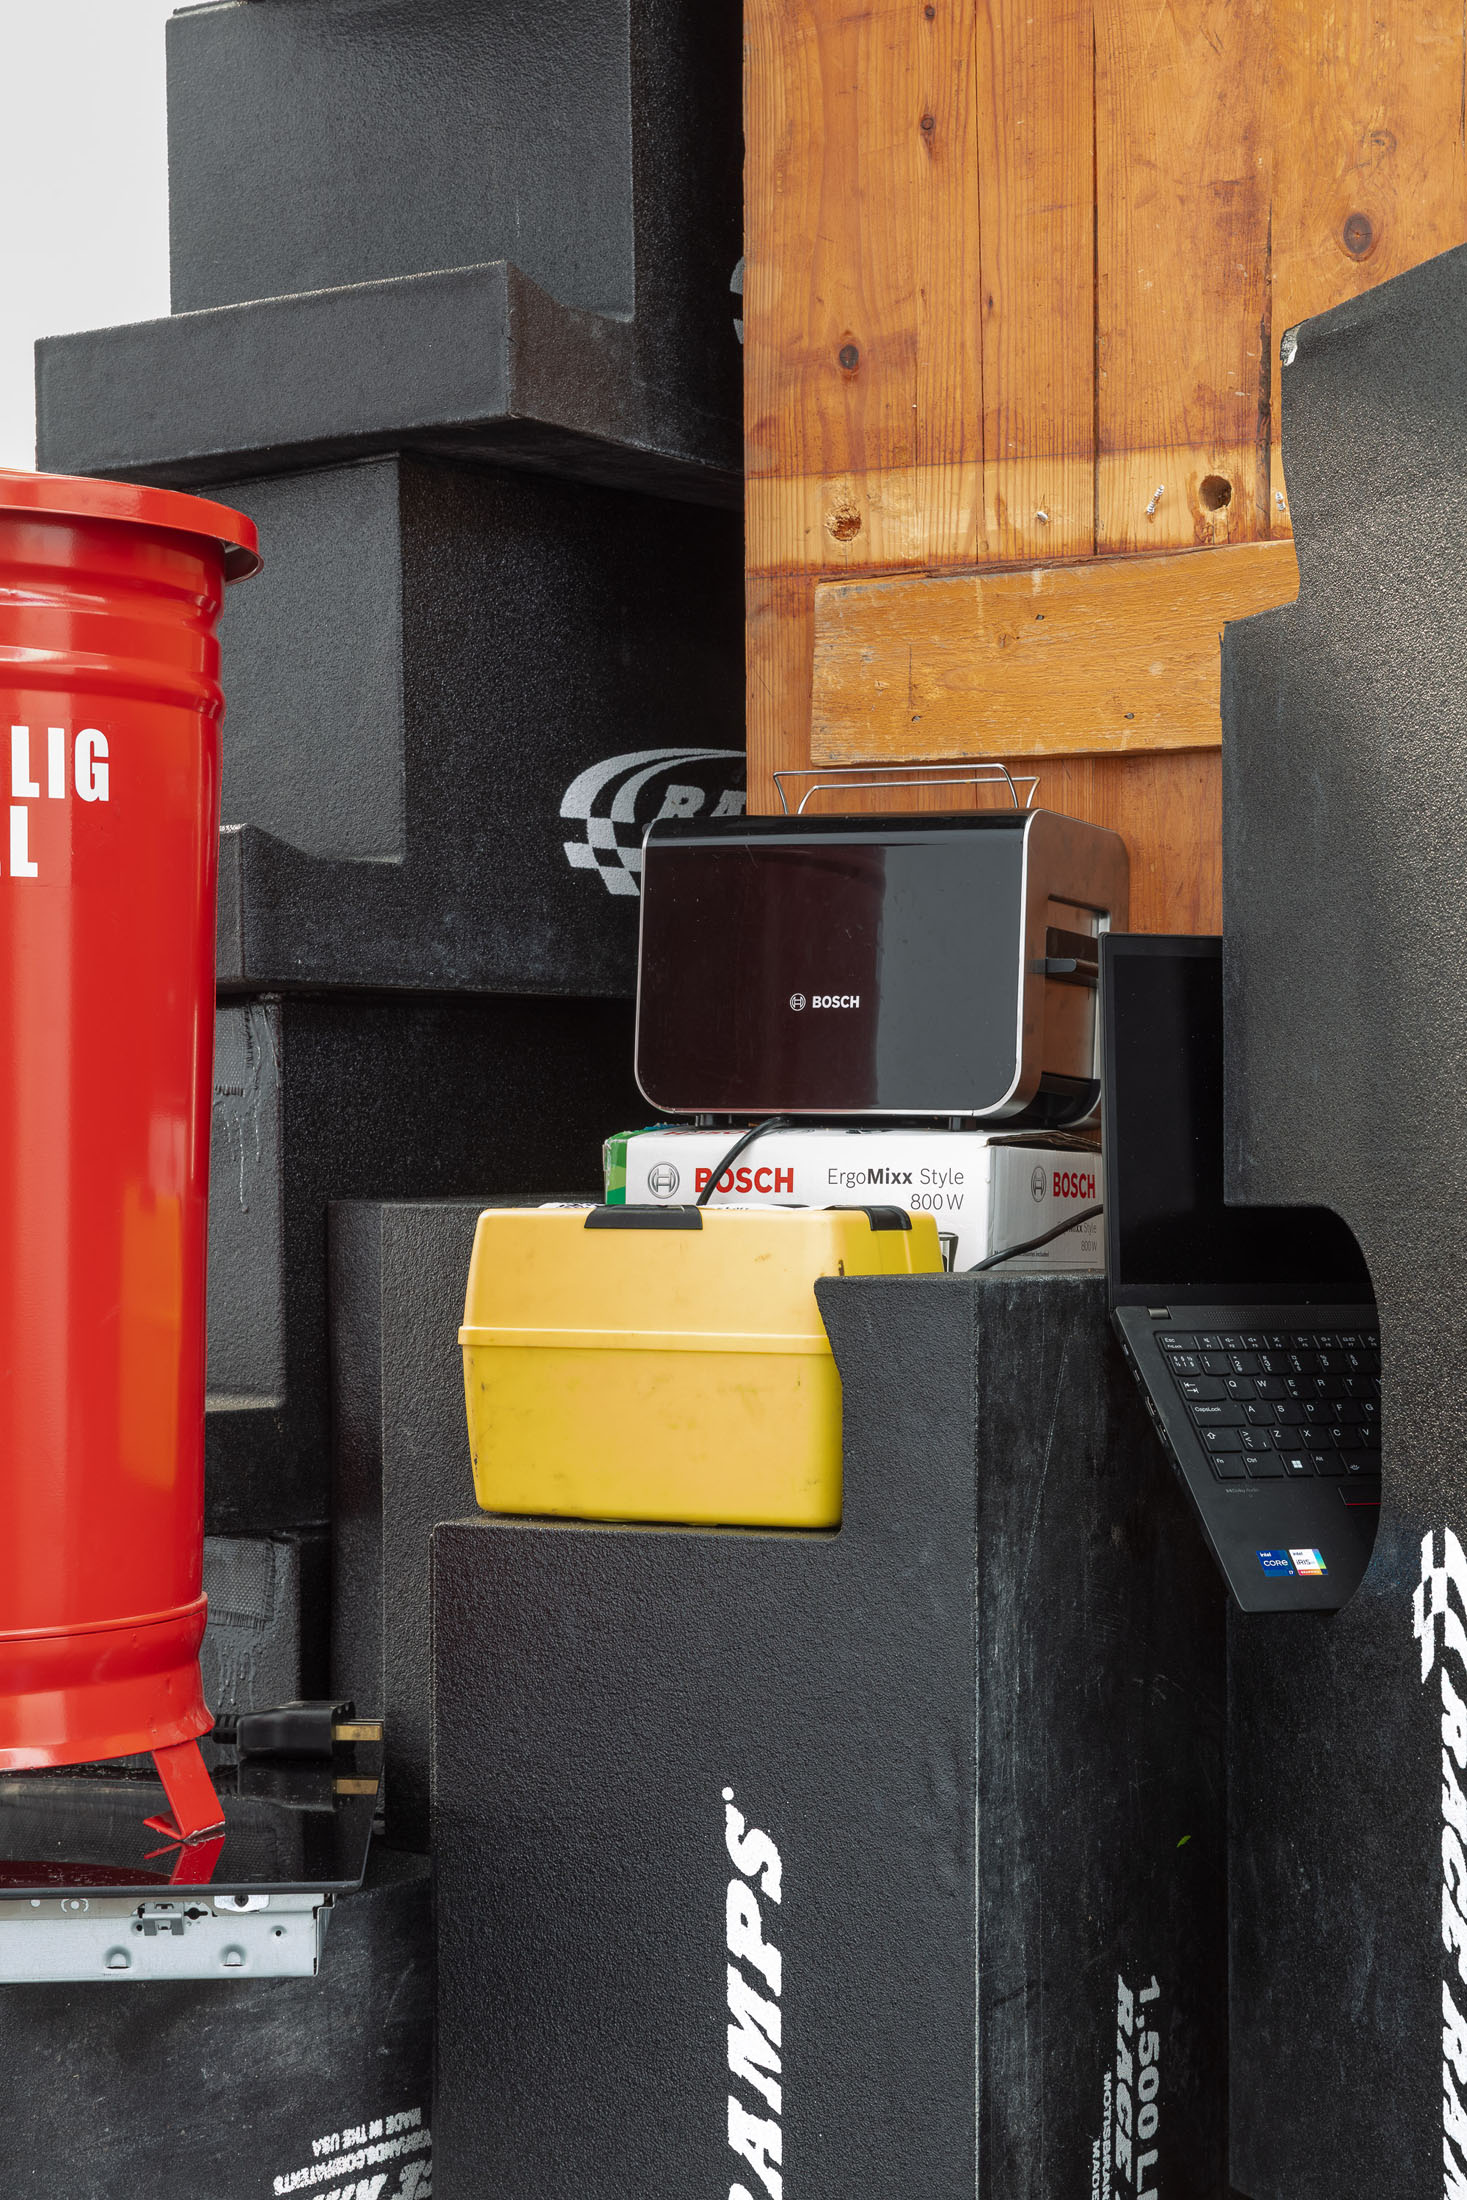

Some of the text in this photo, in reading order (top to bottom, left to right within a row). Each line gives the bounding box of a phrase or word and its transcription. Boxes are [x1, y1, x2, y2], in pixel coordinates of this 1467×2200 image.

[11, 724, 110, 802] LIG
[812, 995, 860, 1009] BOSCH
[694, 1166, 795, 1194] BOSCH
[827, 1167, 965, 1189] ErgoMixx Style
[1052, 1171, 1097, 1199] BOSCH
[910, 1193, 964, 1211] 800 W
[726, 1802, 783, 2200] AMPS
[1135, 1975, 1161, 2140] 1,500
[1115, 1973, 1134, 2183] RACE
